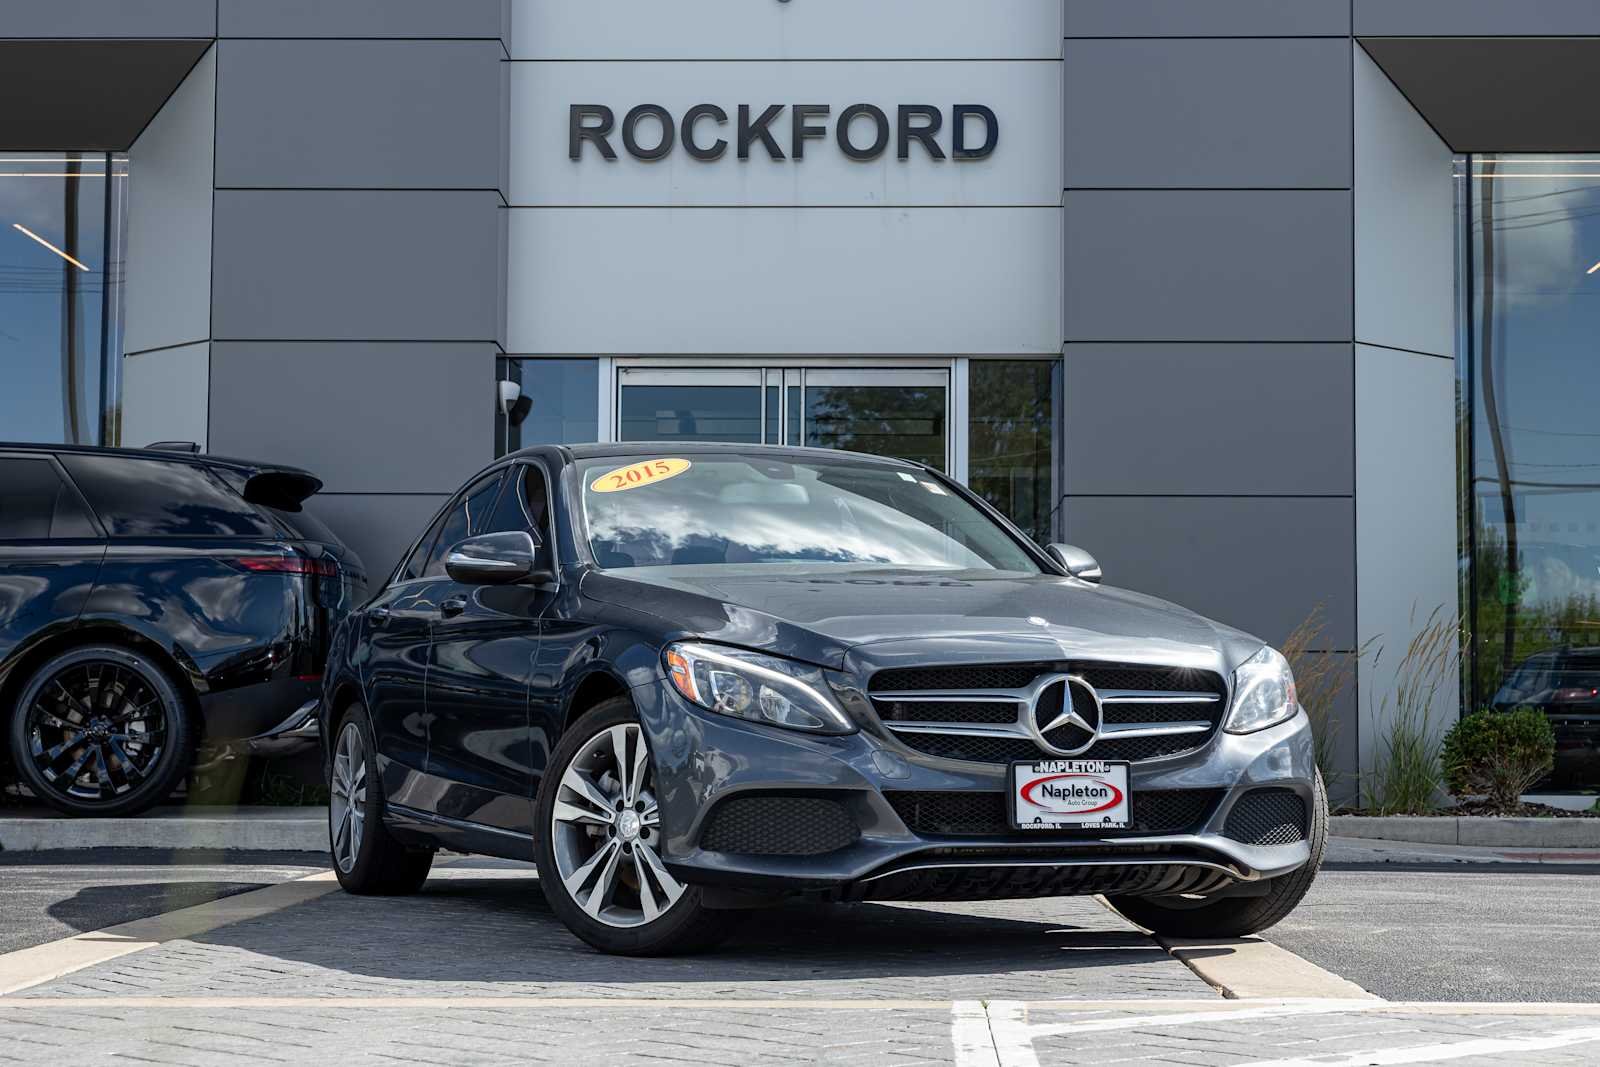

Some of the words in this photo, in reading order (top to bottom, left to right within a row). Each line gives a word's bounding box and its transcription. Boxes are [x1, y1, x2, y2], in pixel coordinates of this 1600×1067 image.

[569, 104, 999, 160] ROCKFORD
[610, 461, 670, 489] 2015
[1040, 761, 1105, 773] NAPLETON
[1042, 784, 1108, 801] Napleton
